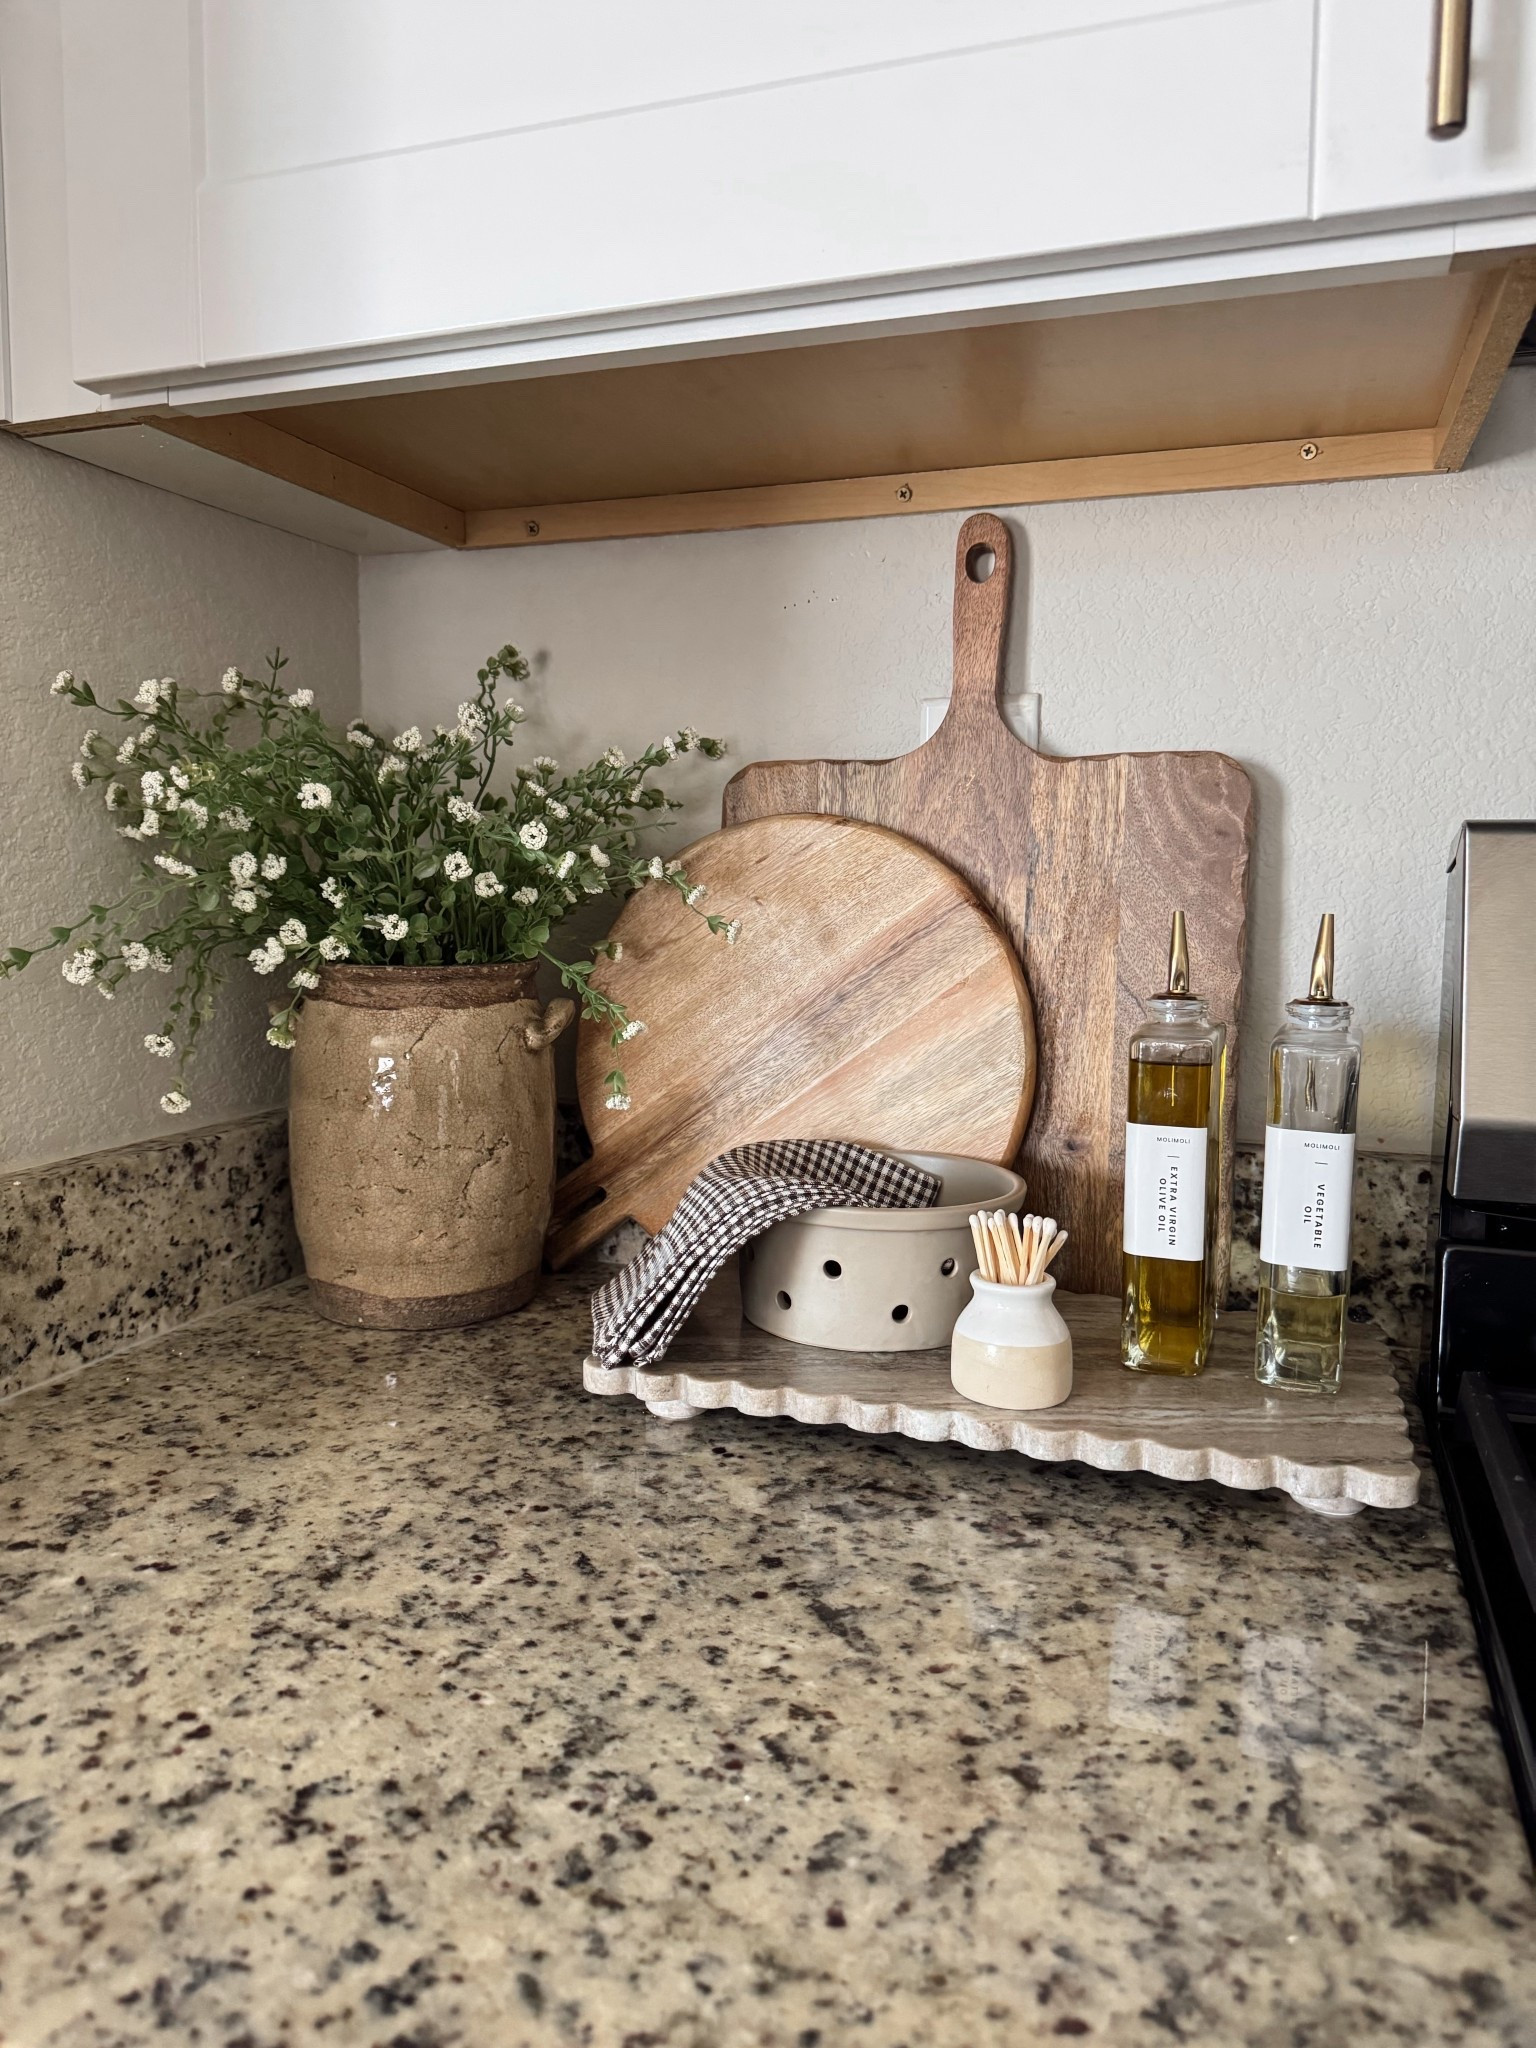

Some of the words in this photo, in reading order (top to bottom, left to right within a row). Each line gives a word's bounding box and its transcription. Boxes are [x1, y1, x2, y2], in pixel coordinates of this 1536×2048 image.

[1156, 1136, 1191, 1144] MOLIMOLI
[1304, 1142, 1340, 1150] MOLIMOLI
[1158, 1178, 1167, 1210] OLIVE
[1170, 1166, 1178, 1201] EXTRA
[1157, 1214, 1166, 1232] OIL
[1168, 1206, 1177, 1246] VIRGIN
[1303, 1206, 1312, 1224] OIL
[1313, 1184, 1325, 1249] VEGETABLE
